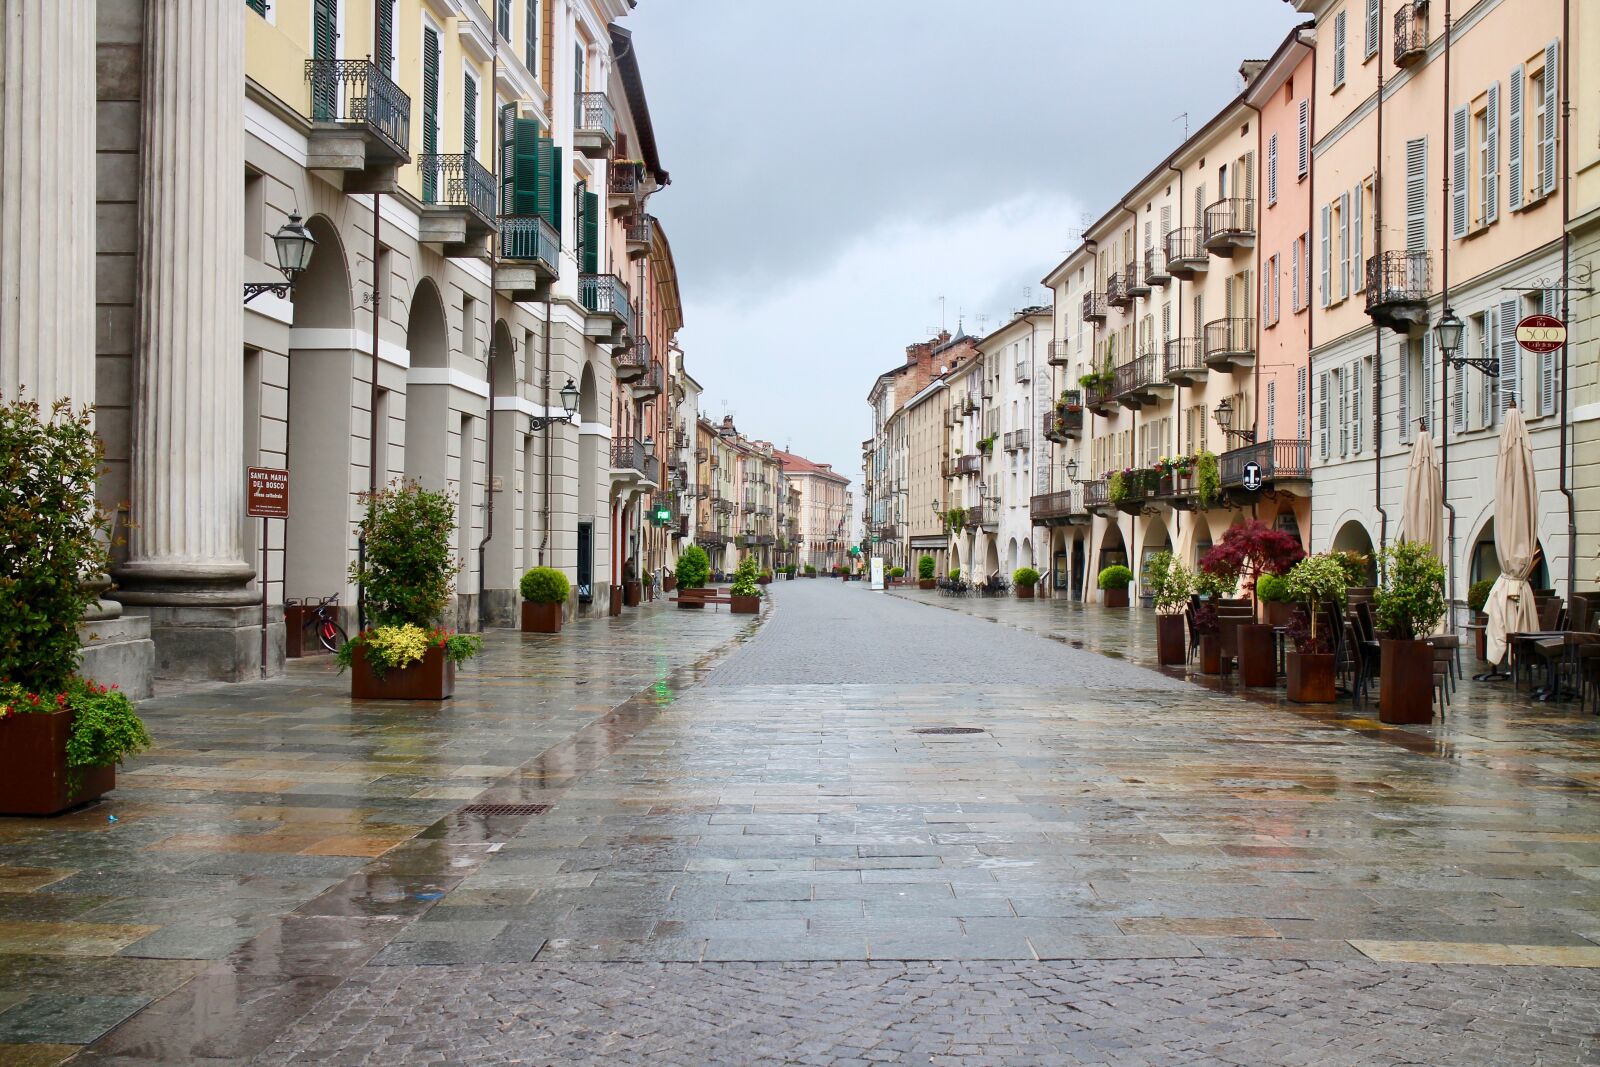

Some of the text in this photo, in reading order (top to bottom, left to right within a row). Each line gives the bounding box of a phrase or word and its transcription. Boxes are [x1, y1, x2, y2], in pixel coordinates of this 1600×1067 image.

[250, 472, 287, 481] SANTA MARIA
[252, 480, 285, 490] DEL BOSCO
